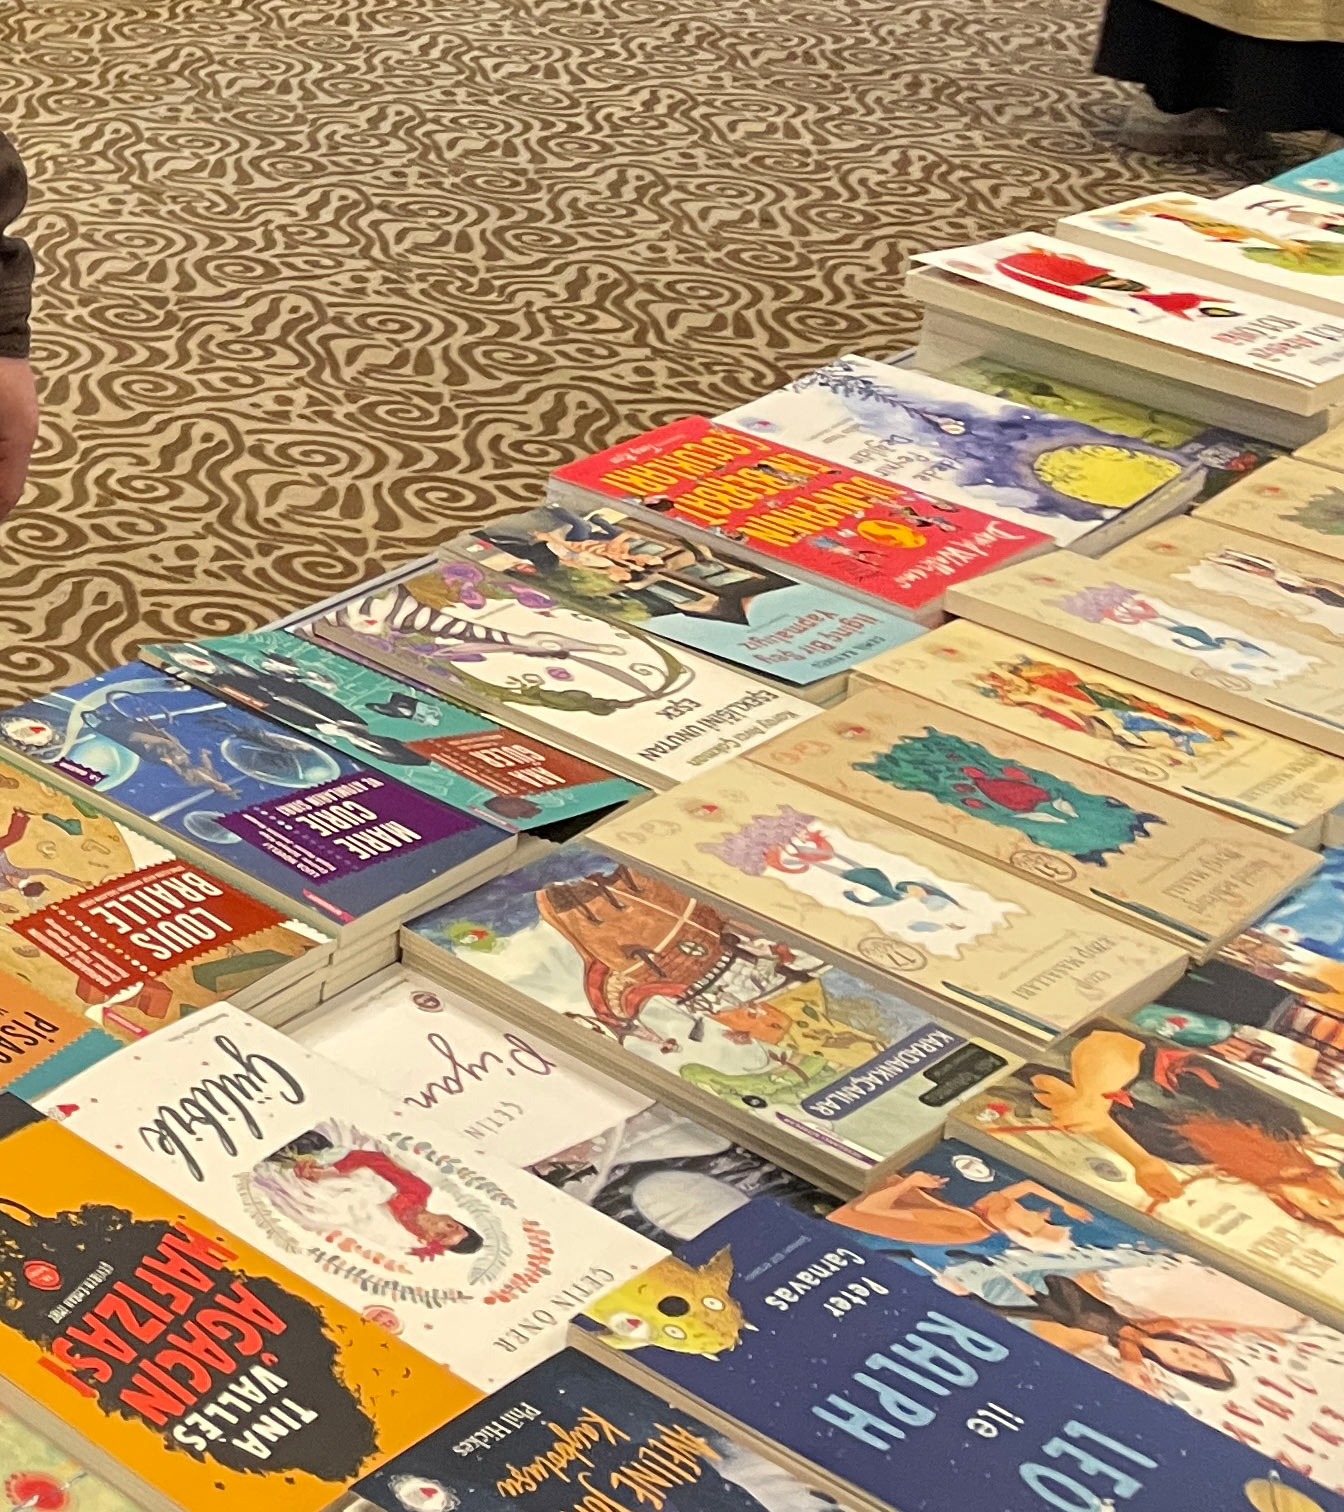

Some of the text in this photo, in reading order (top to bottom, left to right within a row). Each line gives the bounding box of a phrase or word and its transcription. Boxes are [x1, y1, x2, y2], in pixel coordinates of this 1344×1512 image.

[655, 698, 702, 721] EŞEK
[637, 725, 705, 762] UNUTAN
[295, 801, 378, 838] CURIE
[333, 821, 422, 861] MARIE
[88, 871, 224, 934] BRAILLE
[129, 906, 233, 961] LOUIS
[139, 1035, 305, 1182] Gülibik
[765, 1248, 865, 1311] Carnavas
[823, 1276, 889, 1317] Peter
[37, 1222, 238, 1398] HAFIZASI
[119, 1282, 288, 1426] AĞACIN
[811, 1311, 1010, 1452] RALPH
[232, 1398, 318, 1460] TINA
[452, 1402, 541, 1457] Phil Hickes
[966, 1402, 1025, 1439] ile
[1018, 1419, 1159, 1512] LEO
